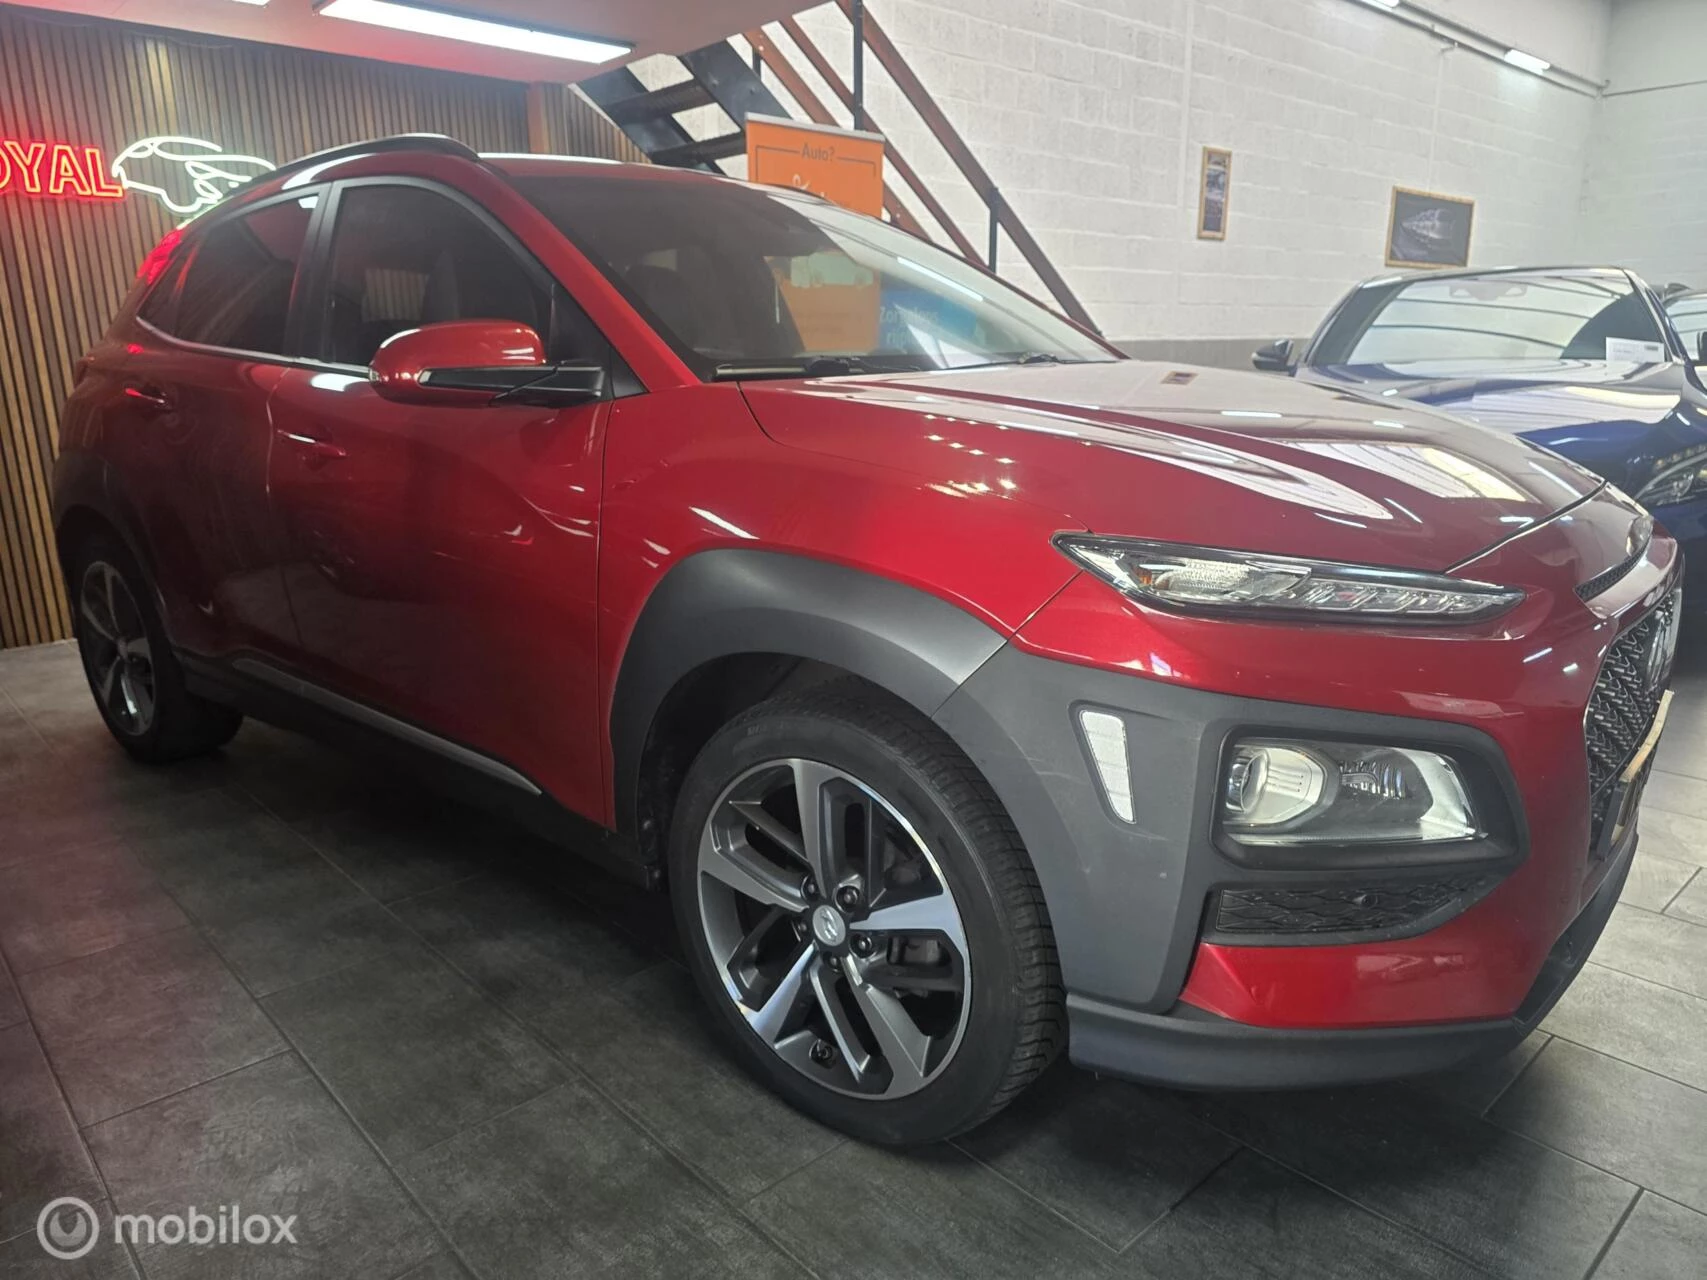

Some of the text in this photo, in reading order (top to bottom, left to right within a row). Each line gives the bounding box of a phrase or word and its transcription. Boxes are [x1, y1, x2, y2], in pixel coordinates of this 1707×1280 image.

[801, 142, 836, 162] Auto?
[0, 140, 123, 197] YAL
[880, 305, 939, 326] Zorgloos
